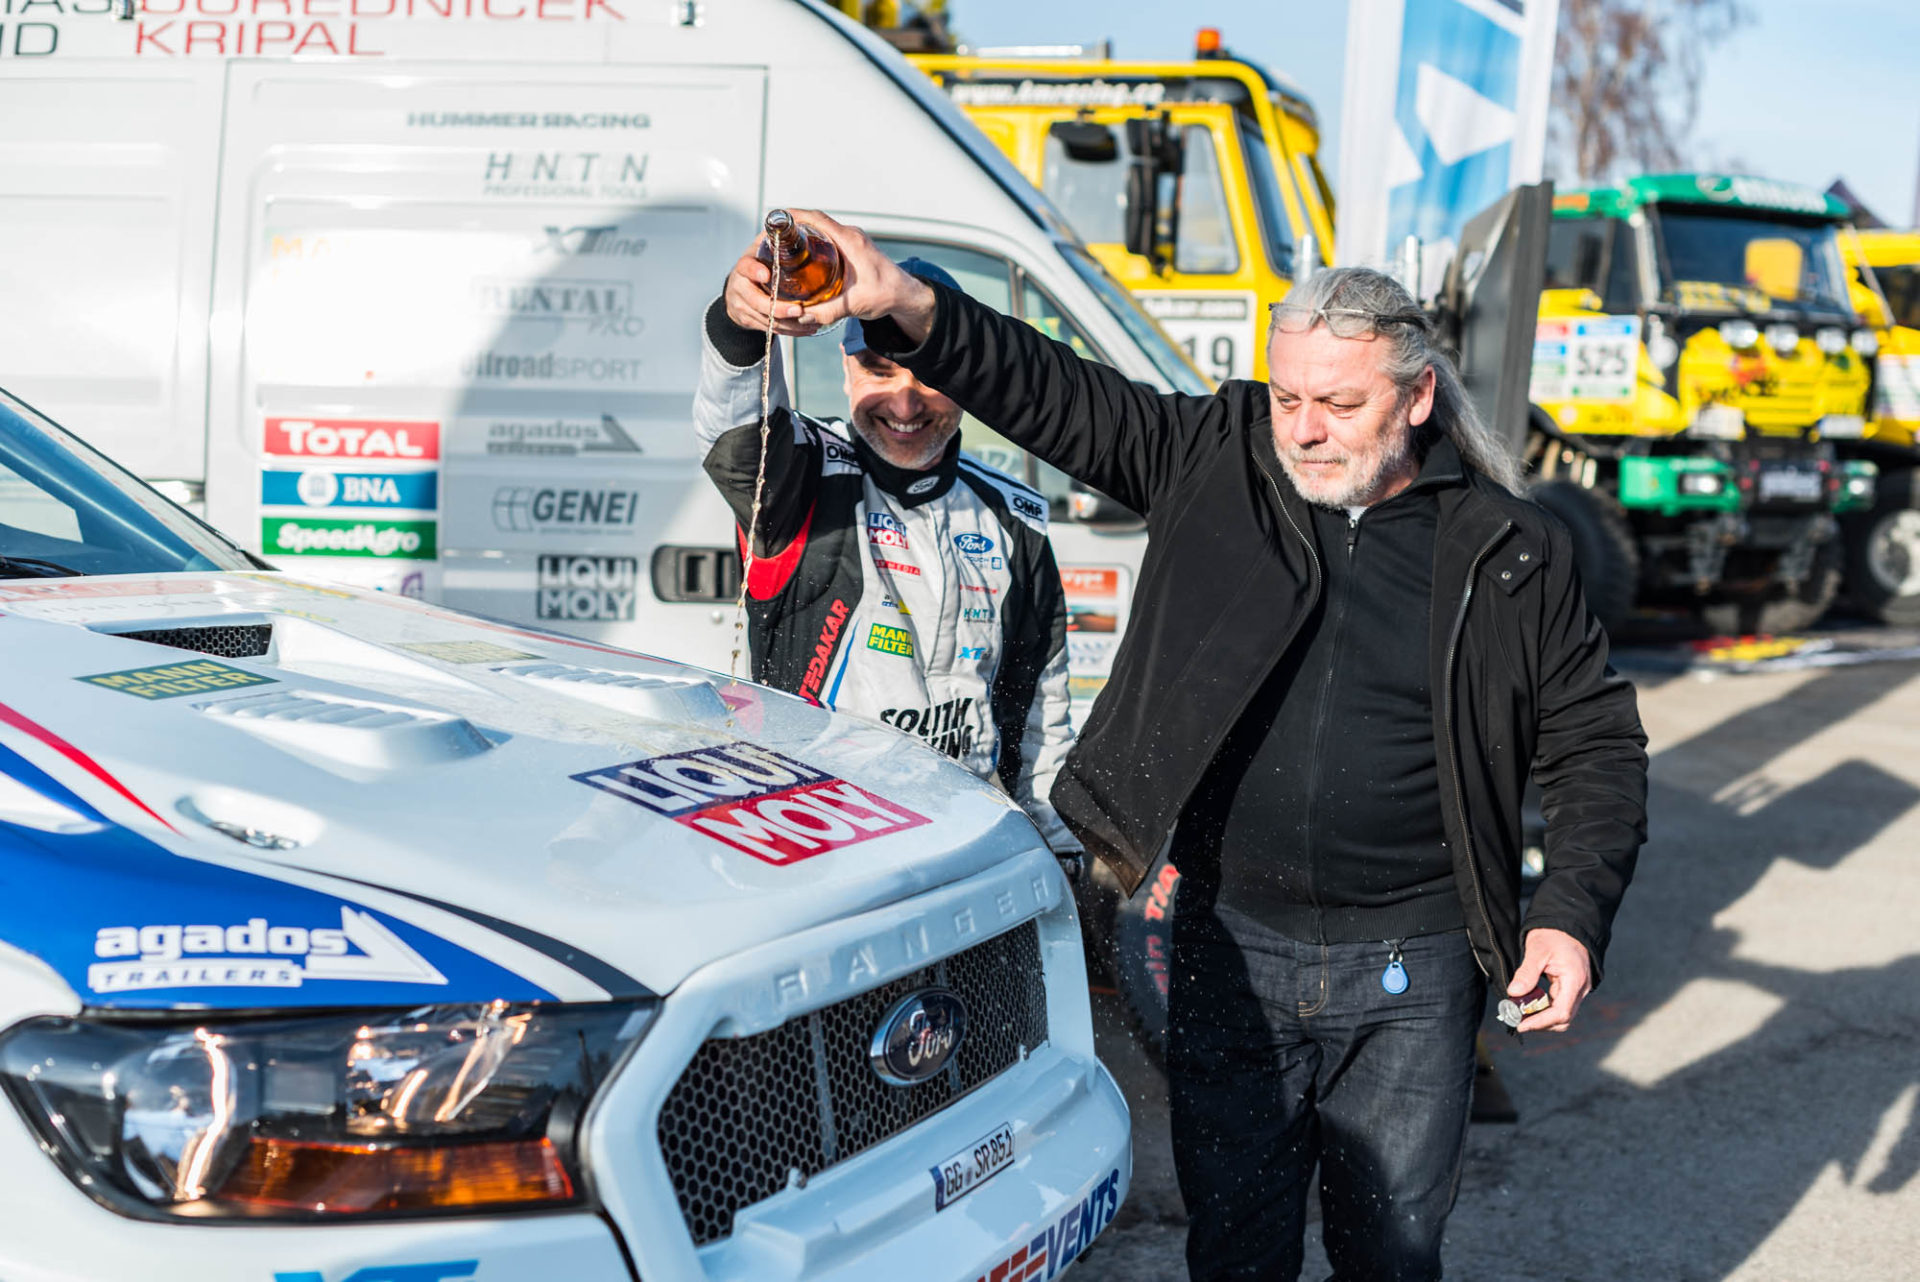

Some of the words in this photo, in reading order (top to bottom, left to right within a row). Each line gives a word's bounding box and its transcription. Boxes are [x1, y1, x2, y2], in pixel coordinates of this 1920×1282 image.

[135, 21, 386, 56] KRIPAL
[1576, 342, 1628, 376] 525
[279, 419, 424, 457] TOTAL
[488, 420, 600, 440] agados
[342, 476, 401, 503] BNA
[532, 488, 639, 526] GENEI
[1012, 497, 1043, 517] OMP
[957, 533, 987, 552] Ford
[540, 556, 636, 588] LIQUI
[539, 588, 634, 619] MOLY
[868, 637, 913, 658] FILTER
[94, 661, 230, 687] MANN
[125, 671, 262, 698] FILTER
[586, 746, 823, 813] LIQUI
[690, 782, 911, 862] MOLY
[94, 918, 348, 960] agados
[773, 878, 1050, 1006] RANGER
[104, 968, 291, 988] TRAILERS
[908, 1008, 953, 1067] Ford
[944, 1161, 963, 1198] GG
[990, 1128, 1014, 1168] 851
